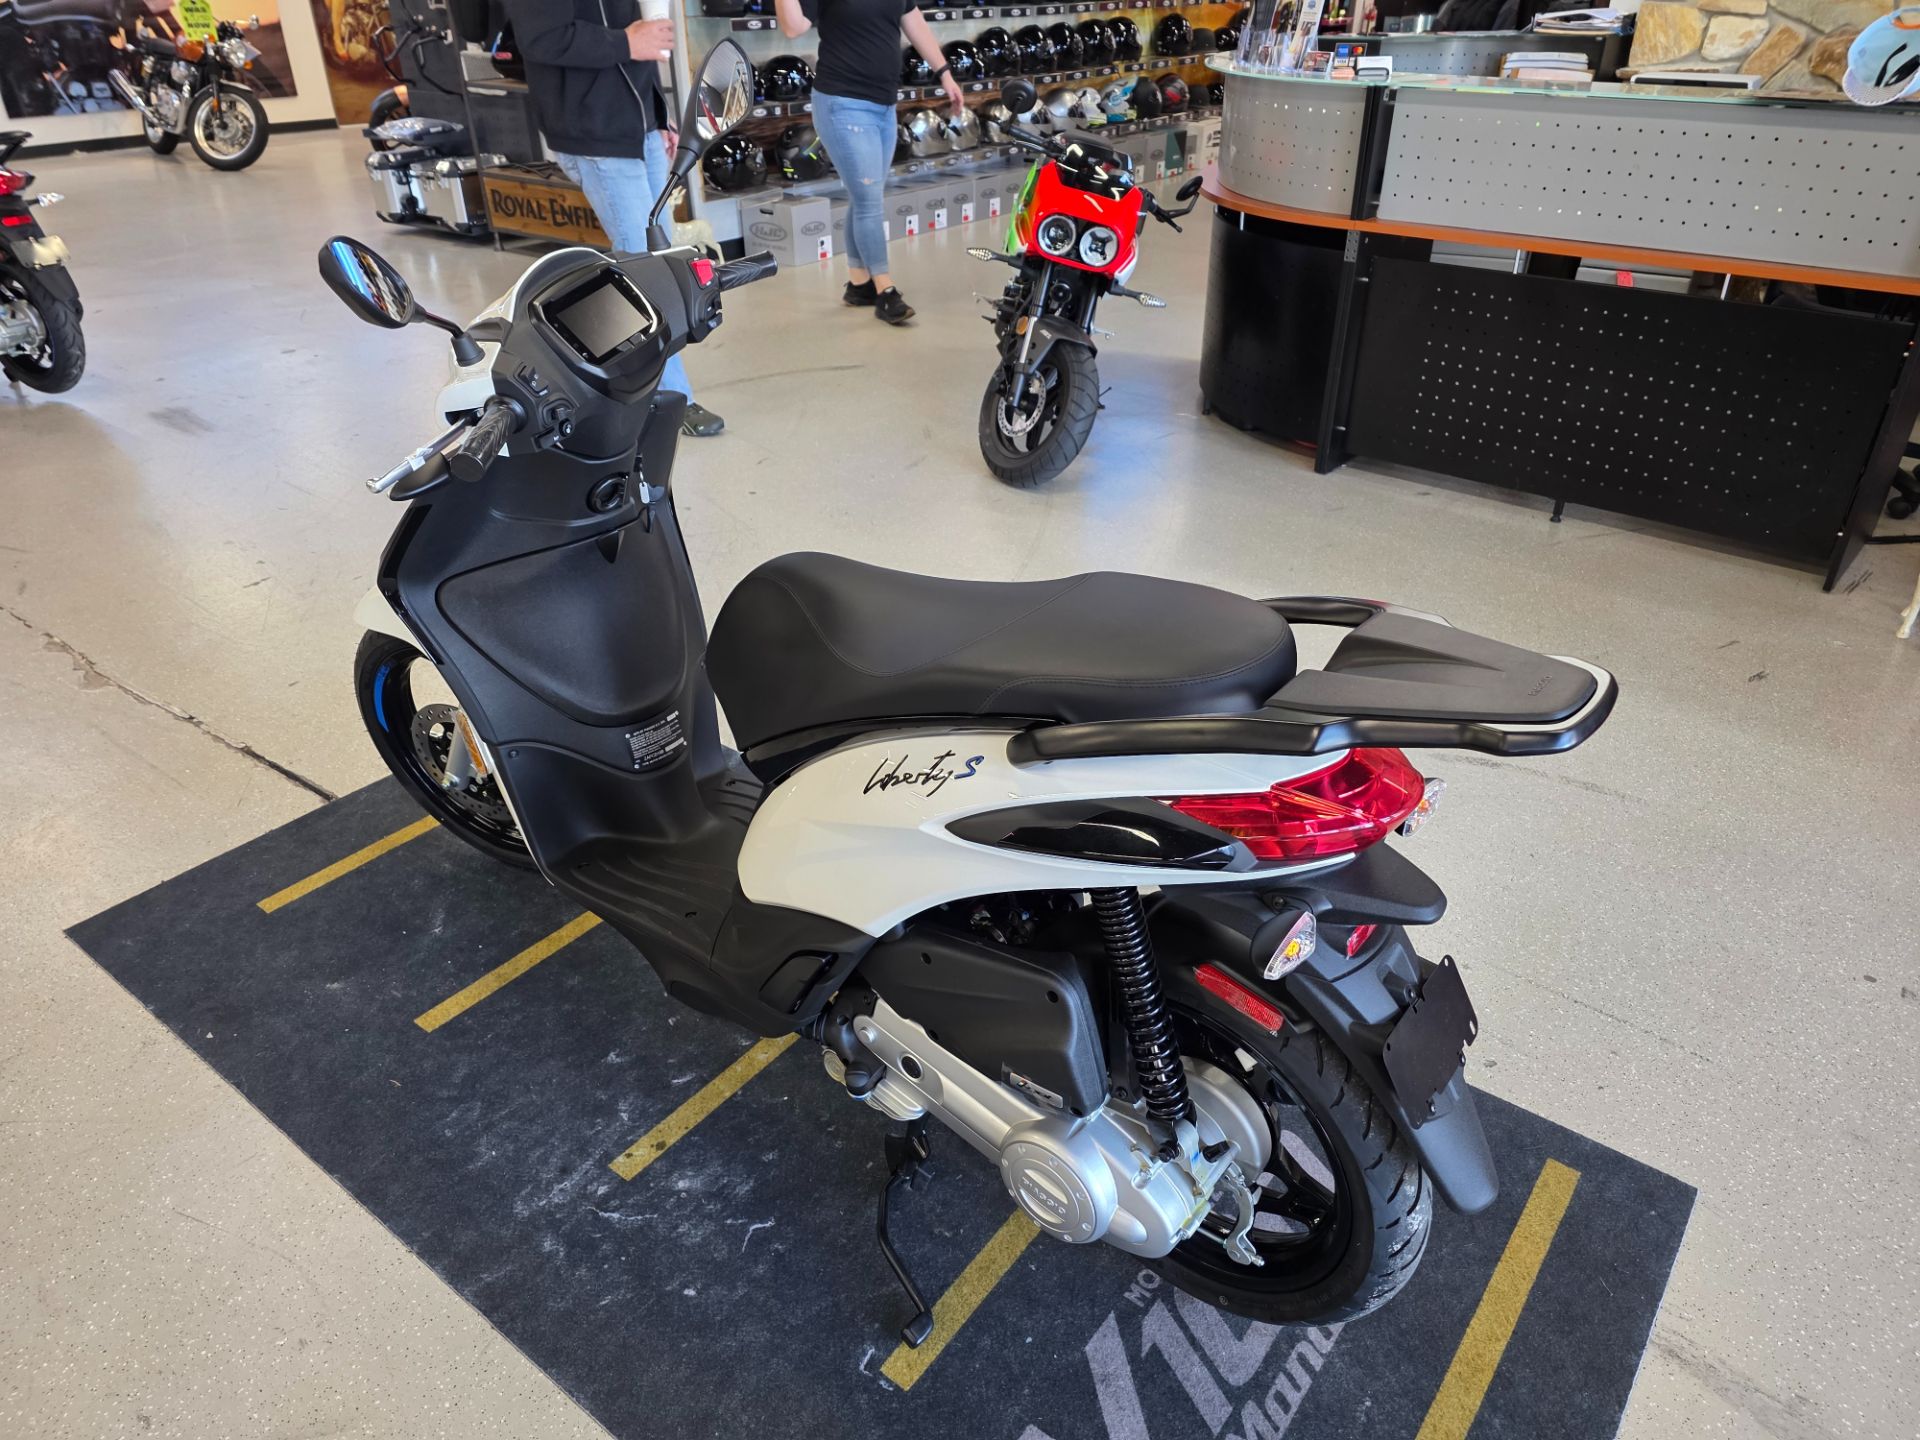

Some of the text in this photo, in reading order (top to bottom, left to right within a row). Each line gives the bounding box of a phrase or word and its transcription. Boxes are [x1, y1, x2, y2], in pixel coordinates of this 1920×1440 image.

[491, 188, 601, 230] ROYAL ENFIE
[753, 224, 784, 239] HJC
[863, 750, 984, 797] Liberty S
[1123, 1267, 1163, 1307] MO
